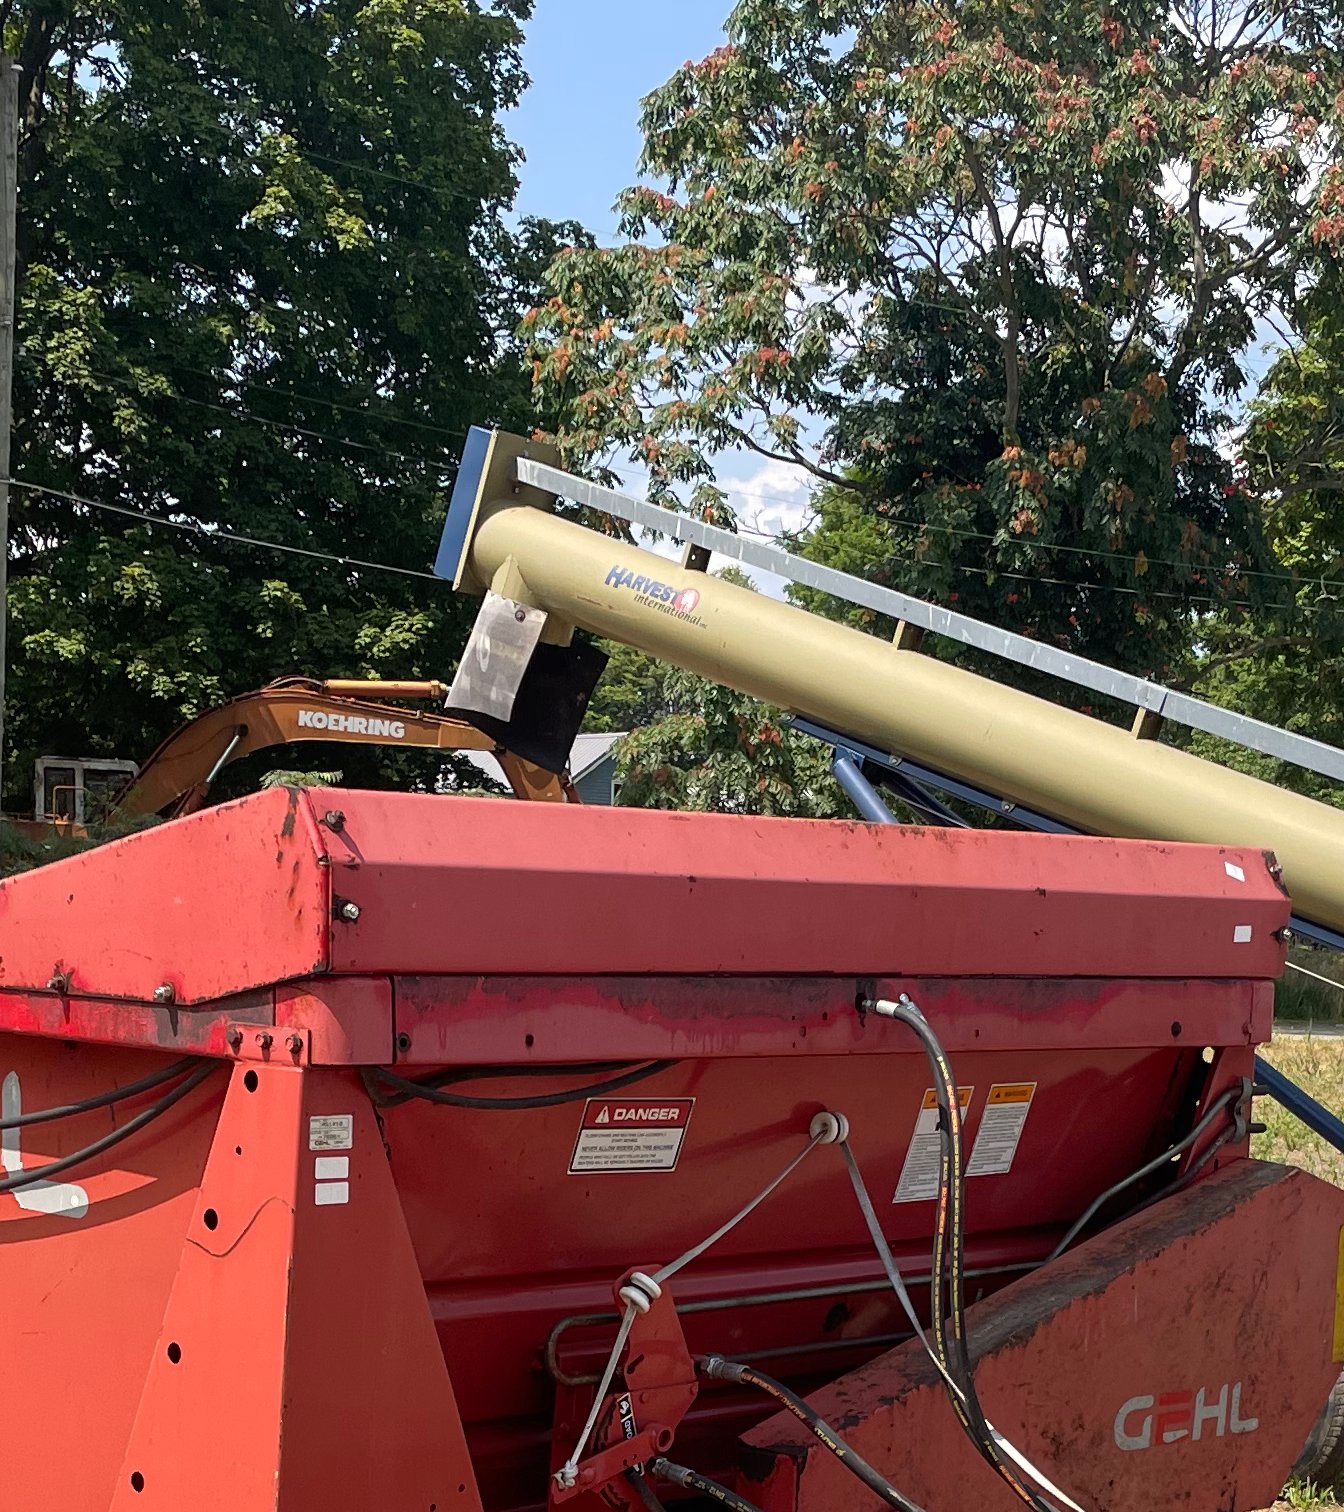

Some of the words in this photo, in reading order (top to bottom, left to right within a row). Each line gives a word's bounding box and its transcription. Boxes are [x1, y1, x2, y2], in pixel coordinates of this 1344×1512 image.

[604, 564, 682, 606] HARVEST
[634, 593, 702, 626] international
[297, 710, 405, 738] KOEHRING
[613, 1108, 680, 1120] DANGER
[1114, 1381, 1259, 1450] GEHL
